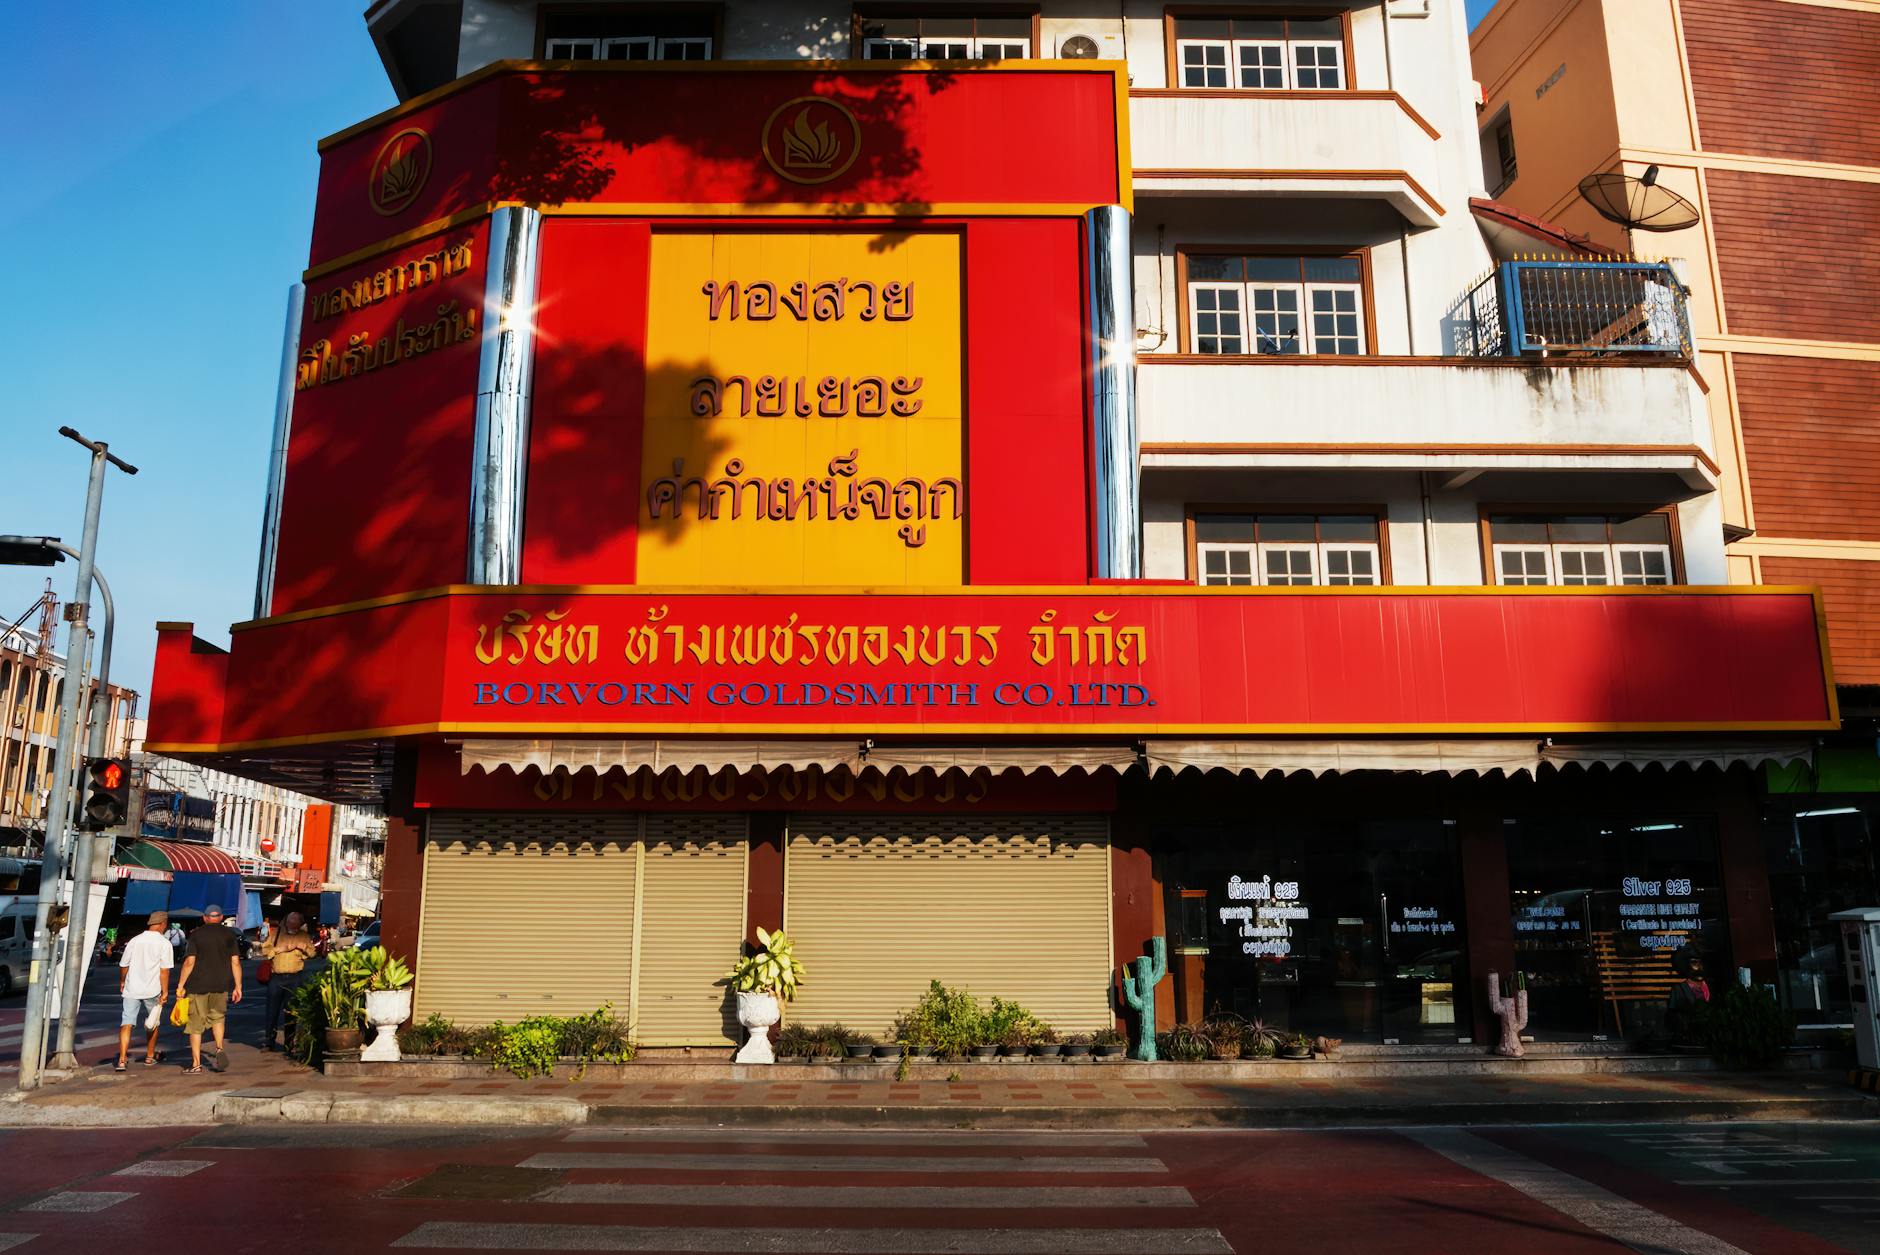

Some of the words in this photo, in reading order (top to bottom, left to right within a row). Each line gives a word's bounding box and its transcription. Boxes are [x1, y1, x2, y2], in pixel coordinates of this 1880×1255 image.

[701, 277, 915, 322] ทองสวย
[690, 375, 925, 418] ลายเยอะ
[474, 607, 600, 666] บริษัท
[624, 604, 1002, 667] ห้างเพชรทองบวร
[1027, 608, 1148, 667] จำกัด
[473, 682, 695, 706] BORVORN
[706, 682, 981, 706] GOLDSMITH
[1274, 882, 1299, 899] 925
[1622, 877, 1662, 896] Silver
[1666, 879, 1692, 896] 925
[1673, 903, 1700, 915] QUALITY
